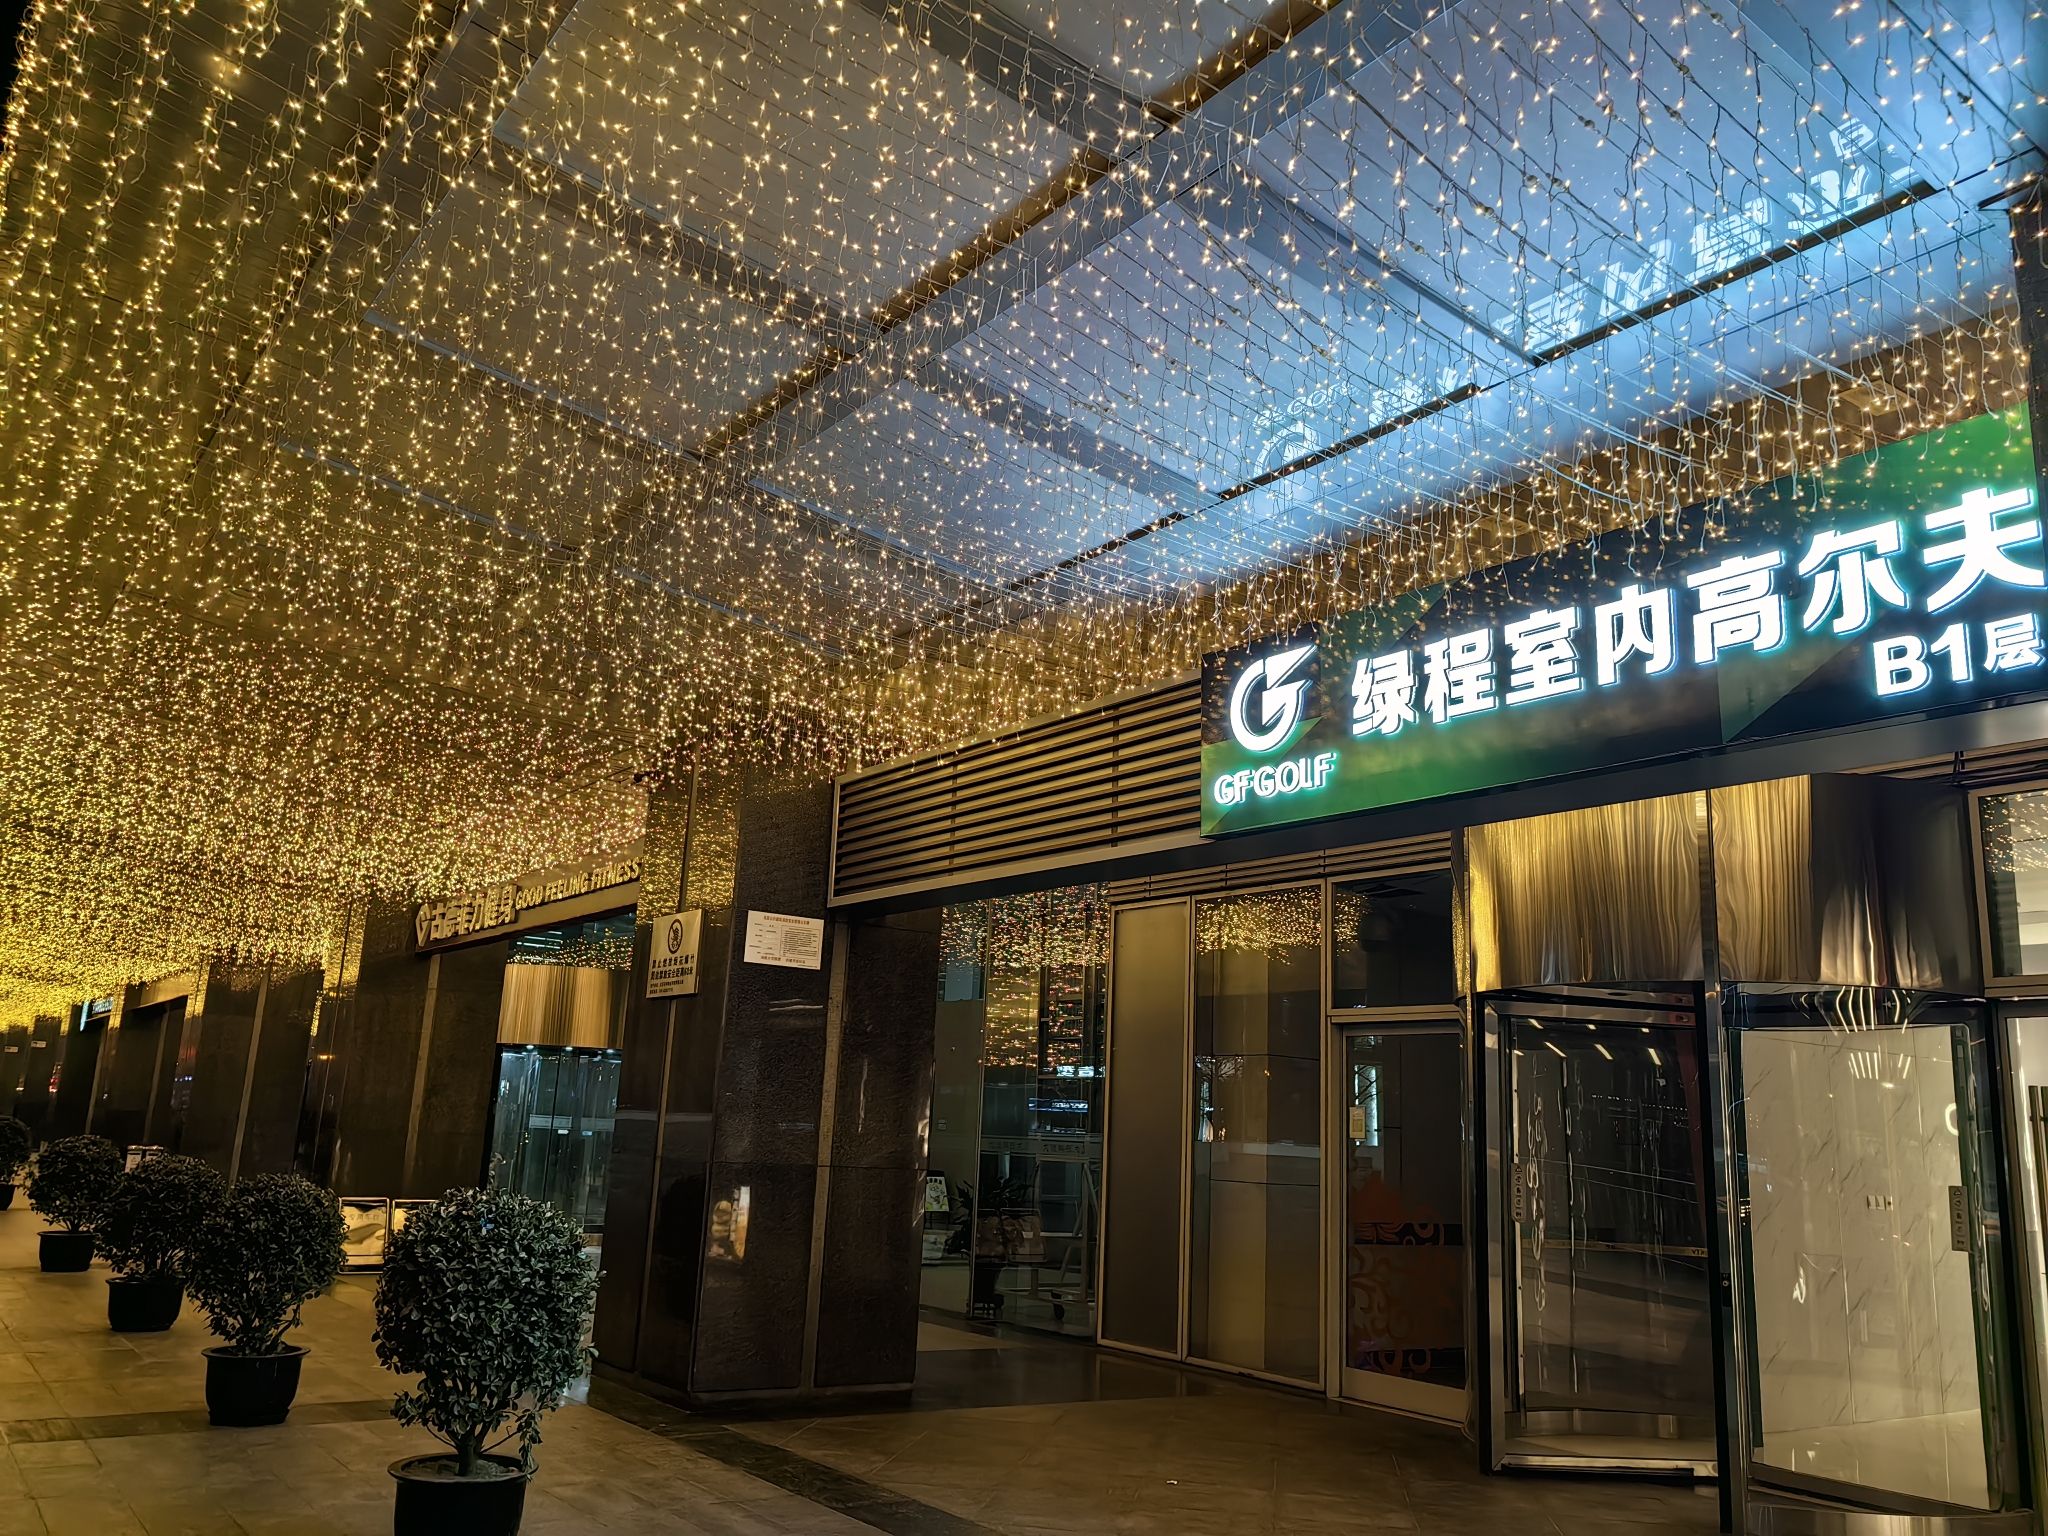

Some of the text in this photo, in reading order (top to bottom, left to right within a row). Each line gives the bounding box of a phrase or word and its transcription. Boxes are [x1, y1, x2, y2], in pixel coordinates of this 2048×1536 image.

[1351, 487, 2047, 737] 绿程室内高尔夫
[1873, 612, 2045, 698] B1层
[1213, 751, 1337, 806] GFGOLF
[515, 886, 543, 910] GOOD
[545, 872, 589, 902] FEELING
[591, 857, 640, 890] FITNESS
